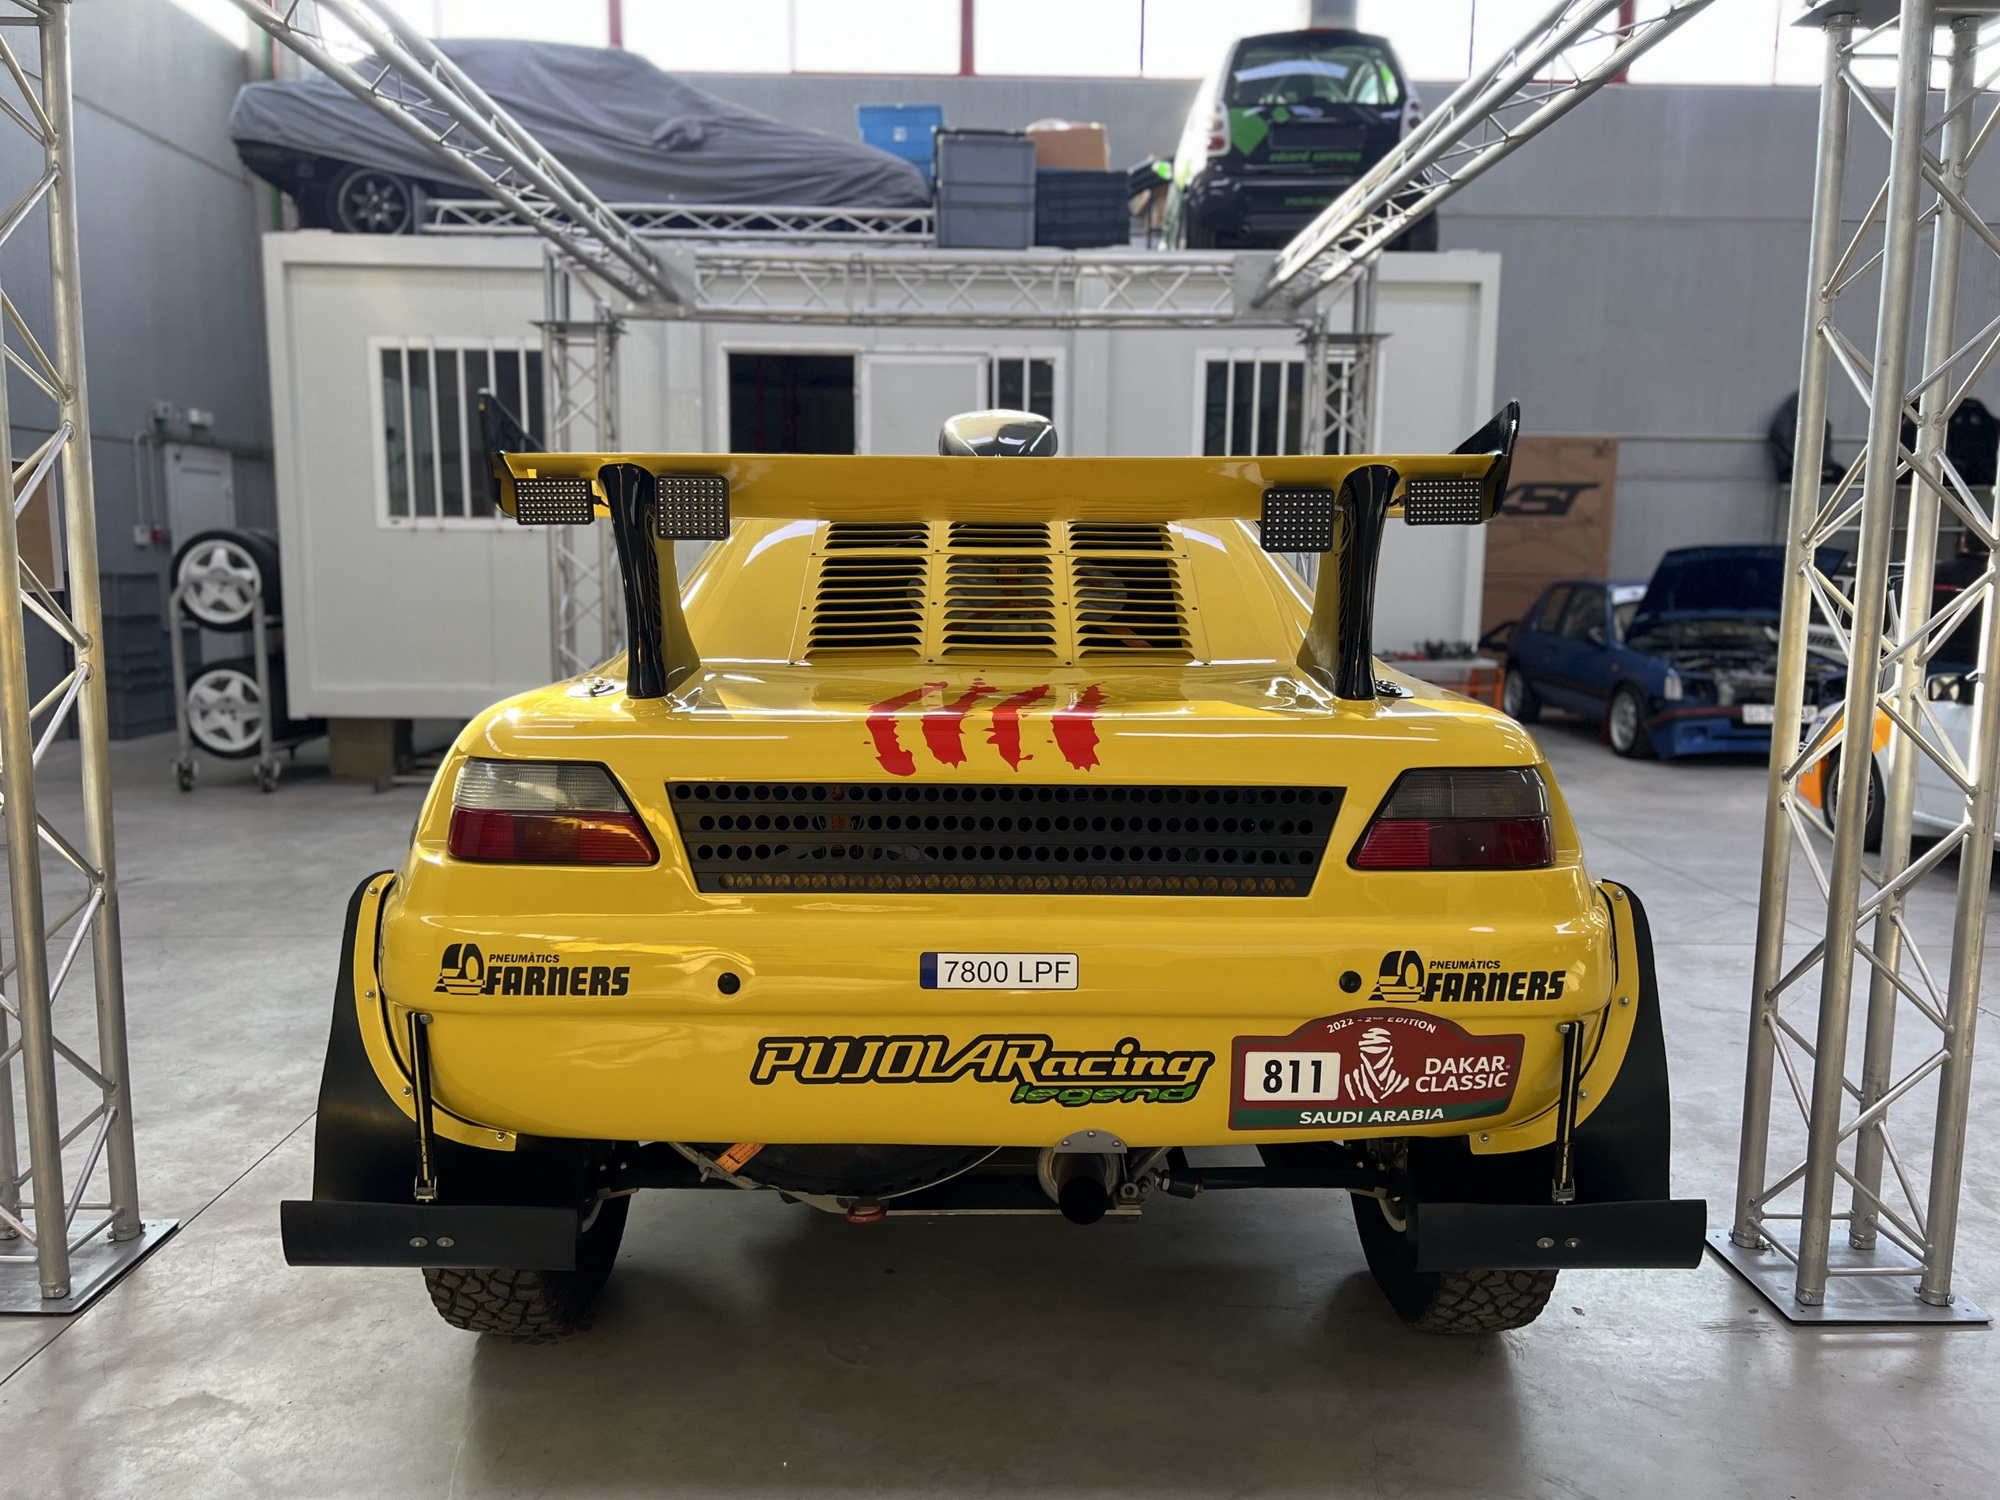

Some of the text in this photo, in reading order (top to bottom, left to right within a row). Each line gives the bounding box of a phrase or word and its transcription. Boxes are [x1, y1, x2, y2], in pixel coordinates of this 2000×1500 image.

[488, 952, 560, 963] PNEUMÀTICS
[1428, 958, 1501, 970] PNEUMÀTICS
[486, 966, 630, 996] FARNERS
[944, 961, 1071, 983] 7800 LPF
[1423, 970, 1566, 1002] FARNERS
[1326, 1018, 1355, 1034] 2022
[1387, 1016, 1437, 1034] EDITION
[1424, 1055, 1506, 1075] DAKAR
[1262, 1060, 1324, 1094] 811
[1415, 1072, 1510, 1093] CLASSIC
[1012, 1084, 1198, 1106] legend
[1299, 1107, 1445, 1125] SAUDI ARABIA
